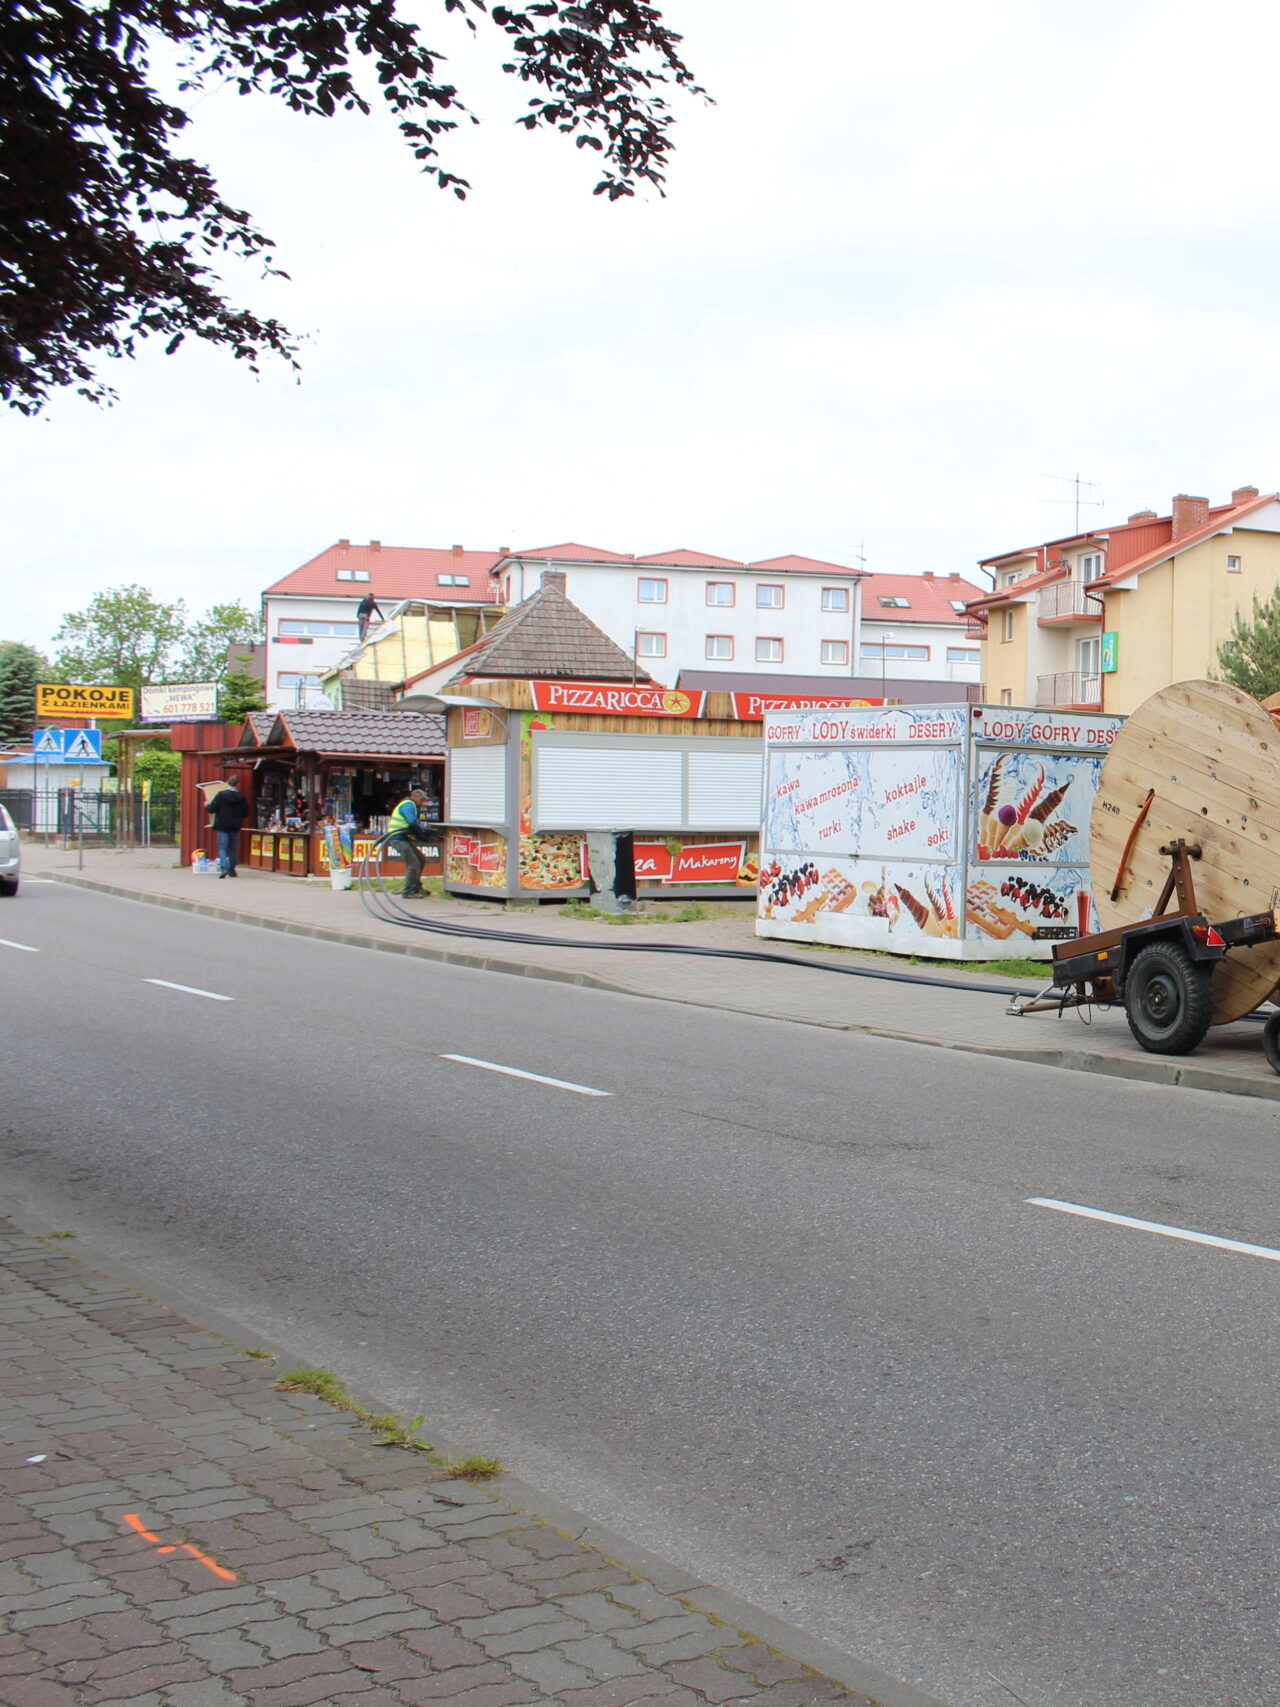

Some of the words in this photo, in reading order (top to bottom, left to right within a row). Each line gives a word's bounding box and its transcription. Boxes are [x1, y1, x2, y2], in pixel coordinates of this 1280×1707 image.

[42, 687, 129, 701] POKOJE
[549, 685, 662, 711] PIZZARICCA
[54, 700, 129, 709] ŁAZIENKAMI
[163, 704, 178, 713] 601
[182, 703, 197, 712] 778
[199, 702, 214, 711] 521
[768, 725, 801, 740] GOFRY
[812, 721, 849, 740] LODY
[850, 722, 896, 740] świderki
[908, 722, 955, 739] DESERY
[983, 721, 1025, 738] LODY
[1031, 725, 1081, 742] GOFRY
[776, 778, 800, 798] kawa
[884, 774, 927, 804] koktajle
[793, 797, 818, 815] kawa
[1102, 800, 1120, 816] H240
[818, 819, 842, 840] rurki
[886, 819, 916, 841] shake
[927, 827, 949, 847] soki
[678, 854, 737, 872] Makarony
